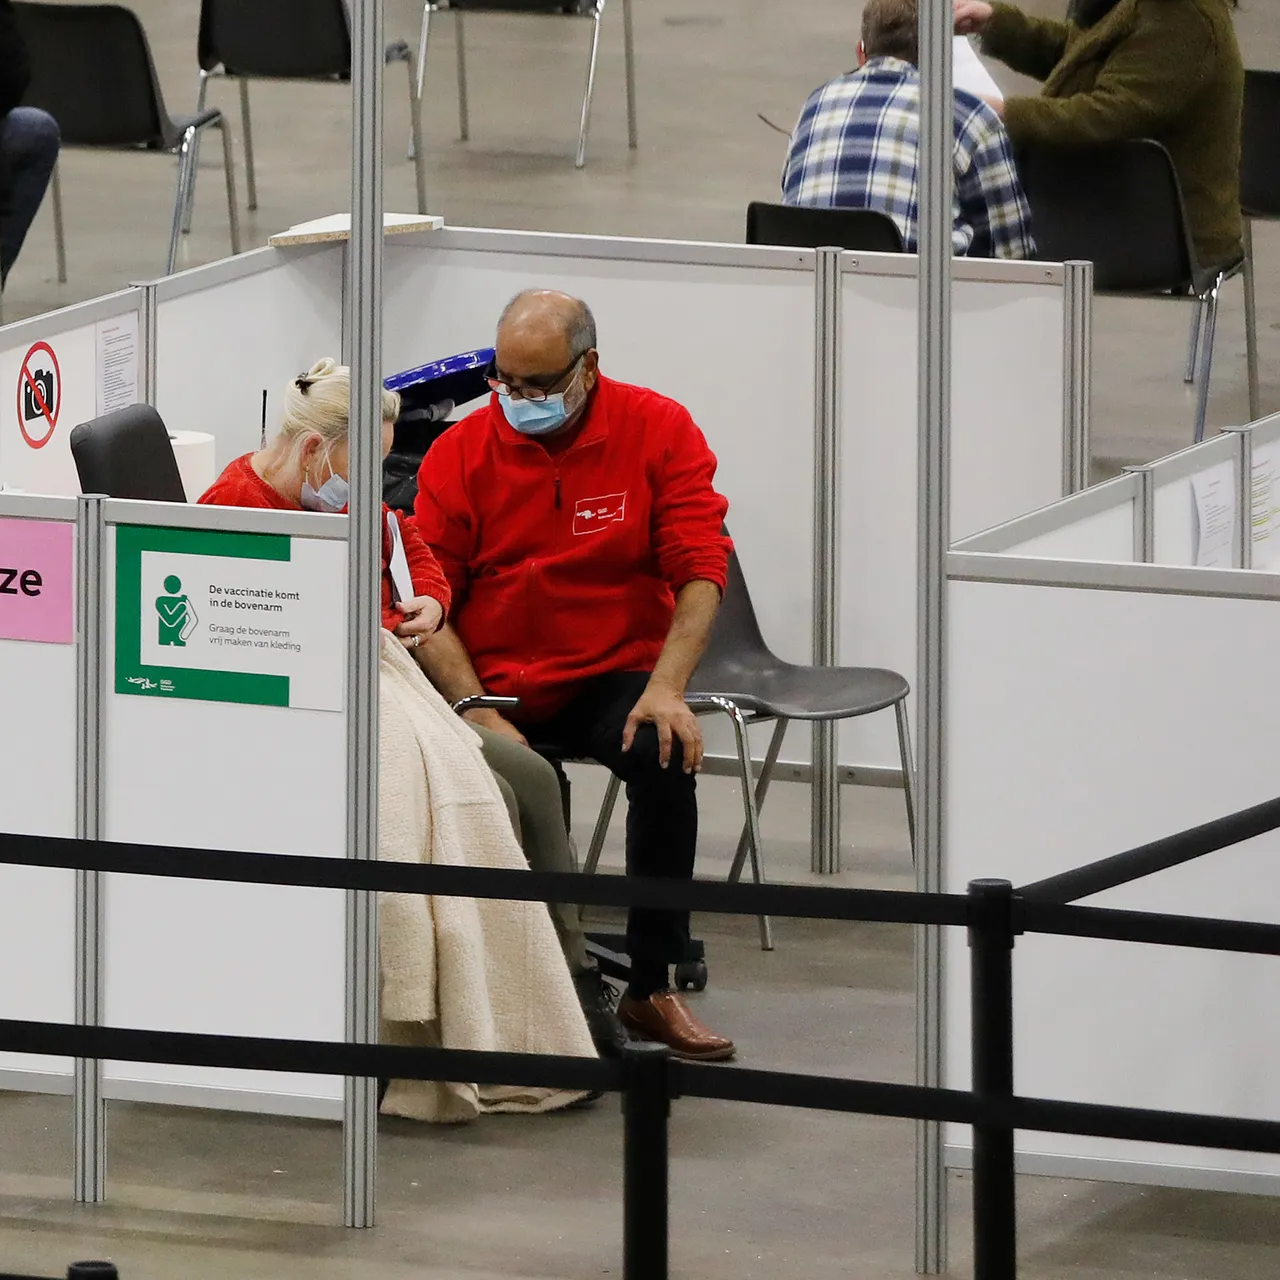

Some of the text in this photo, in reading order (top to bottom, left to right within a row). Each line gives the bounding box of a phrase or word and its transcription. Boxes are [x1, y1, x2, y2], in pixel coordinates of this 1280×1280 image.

[209, 584, 300, 601] De vaccinatie komt
[209, 598, 283, 612] in de bovenarm
[208, 623, 290, 637] Graag de bovenarm
[209, 636, 301, 653] vrij maken van kleding
